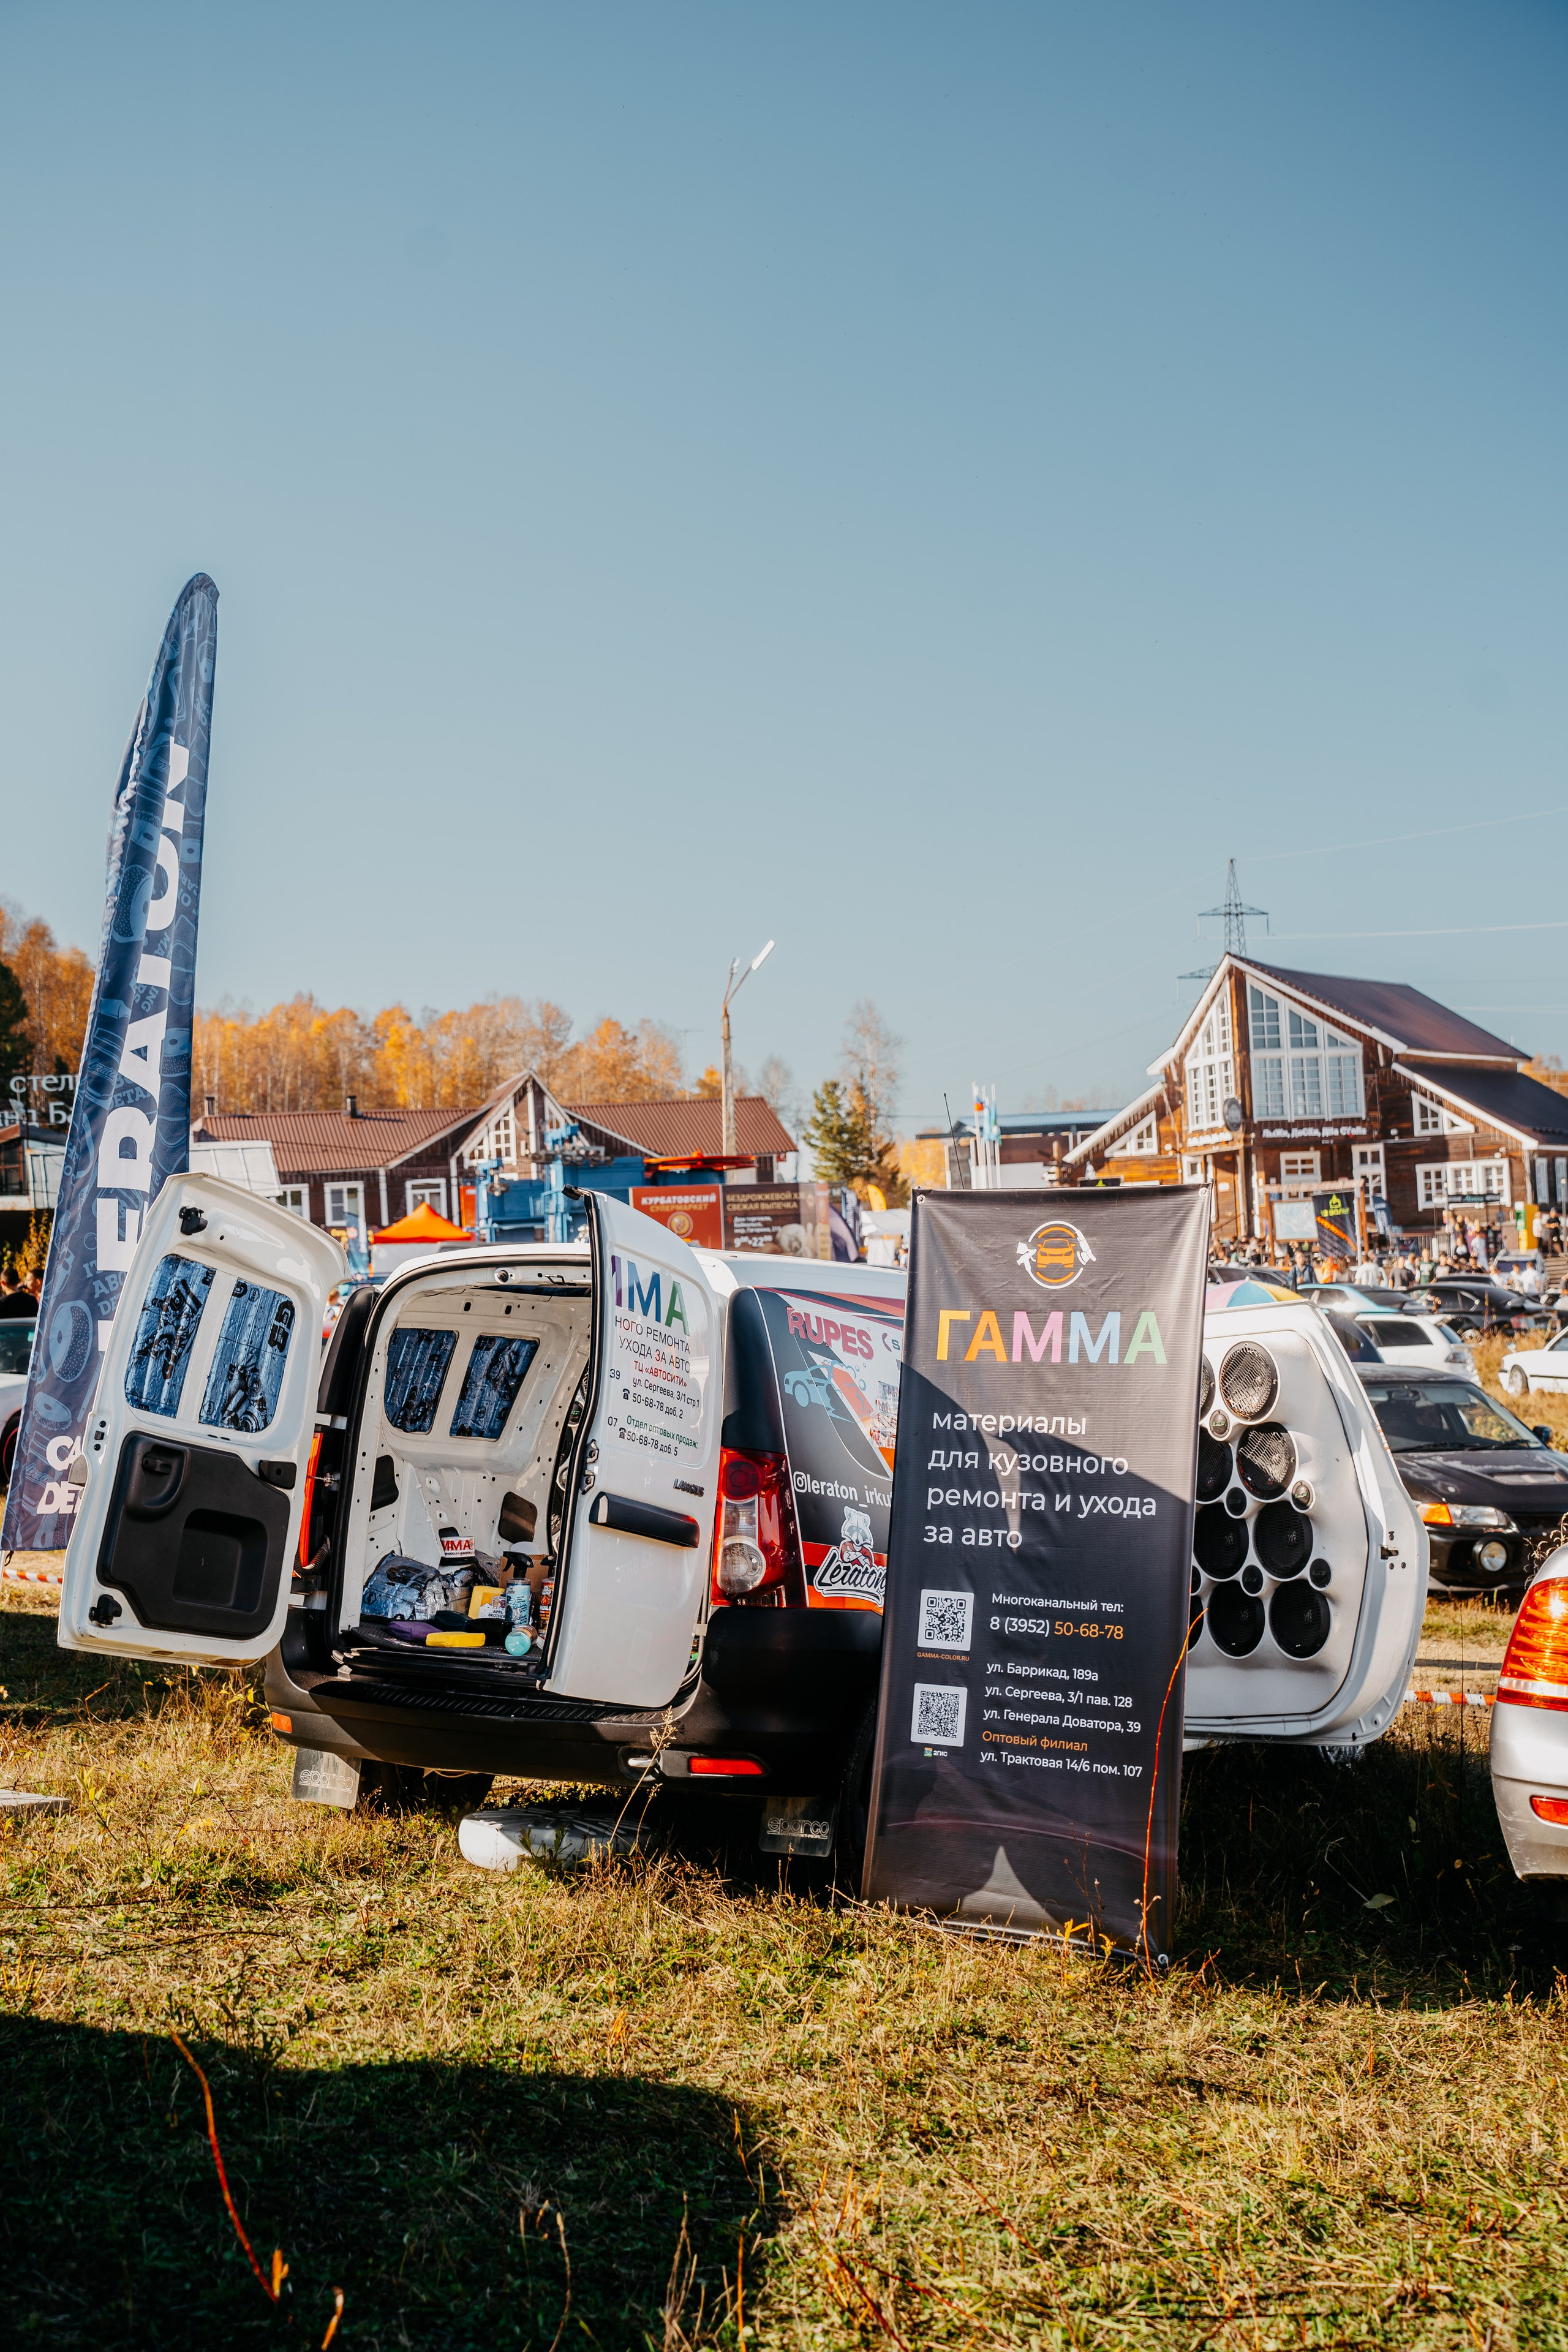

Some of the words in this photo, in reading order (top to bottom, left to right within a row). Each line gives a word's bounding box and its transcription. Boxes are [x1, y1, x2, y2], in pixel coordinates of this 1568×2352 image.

[641, 1193, 717, 1205] КУРБАТОВСКИЙ
[646, 1327, 690, 1355] РЕМОНТА
[786, 1306, 874, 1360] RUPES
[935, 1310, 1167, 1365] ГАММА
[619, 1336, 652, 1359] УХОДА
[655, 1349, 666, 1364] ЗА
[669, 1355, 690, 1373] АВТО
[609, 1368, 620, 1379] 39
[634, 1360, 643, 1373] ТЦ
[645, 1366, 687, 1387] «АВТОСИТИ»
[633, 1378, 643, 1387] ул.
[644, 1379, 675, 1400] Сергеева,
[676, 1391, 686, 1403] 3/1
[632, 1392, 664, 1412] 50-68-78
[665, 1406, 678, 1417] доб.
[679, 1409, 684, 1419] 2
[608, 1416, 618, 1427] 07
[627, 1415, 647, 1430] Отдел
[649, 1423, 675, 1440] оптовых
[676, 1433, 698, 1449] продаж:
[933, 1412, 1087, 1437] материалы
[46, 1435, 81, 1471] CA
[627, 1431, 658, 1449] 50-68-78
[659, 1444, 673, 1455] доб.
[673, 1447, 678, 1457] 5
[927, 1449, 978, 1471] для
[989, 1452, 1128, 1476] кузовного
[807, 1474, 892, 1508] leraton_irku
[927, 1487, 1046, 1512] ремонта
[1055, 1494, 1071, 1512] и
[1078, 1495, 1156, 1518] ухода
[923, 1525, 954, 1545] за
[962, 1528, 1023, 1548] авто
[992, 1593, 1098, 1611] Многоканальный
[1101, 1601, 1124, 1613] тел:
[989, 1616, 1000, 1630] 8
[1005, 1617, 1050, 1637] (3952)
[1054, 1621, 1124, 1640] 50-68-78
[917, 1651, 970, 1662] GAMMA-COLOR.RU
[986, 1662, 1004, 1675] ул.
[1007, 1662, 1070, 1681] Баррикад,
[1072, 1668, 1098, 1681] 189а
[984, 1686, 1002, 1698] ул.
[1005, 1686, 1065, 1703] Сергеева,
[1067, 1691, 1084, 1705] 3/1
[1086, 1695, 1111, 1707] пав.
[1114, 1696, 1133, 1708] 128
[982, 1709, 1000, 1721] ул.
[1003, 1709, 1060, 1725] Генерала
[1061, 1715, 1125, 1733] Доватора,
[1126, 1721, 1141, 1733] 39
[982, 1731, 1037, 1747] Оптовый
[1041, 1737, 1088, 1752] филиал
[980, 1751, 998, 1763] ул.
[1000, 1752, 1063, 1769] Трактовая
[1066, 1758, 1090, 1772] 14/6
[1093, 1764, 1121, 1776] пом.
[1123, 1765, 1143, 1777] 107
[767, 1817, 829, 1836] sparco
